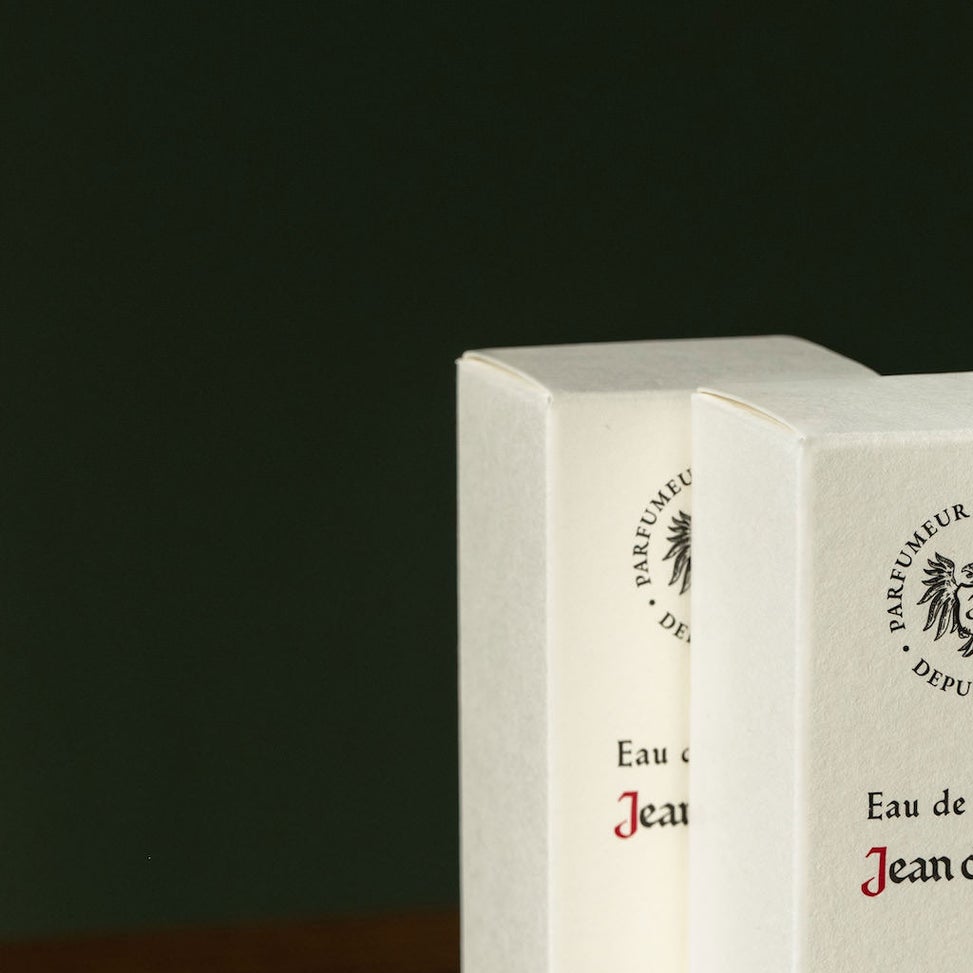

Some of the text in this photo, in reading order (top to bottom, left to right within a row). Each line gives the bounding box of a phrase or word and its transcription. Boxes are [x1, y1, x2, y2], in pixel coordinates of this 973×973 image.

[887, 503, 970, 632] PARFUMEUR
[618, 739, 667, 767] Eau
[867, 791, 920, 820] Eau
[933, 788, 966, 816] de
[861, 846, 954, 897] Jean
